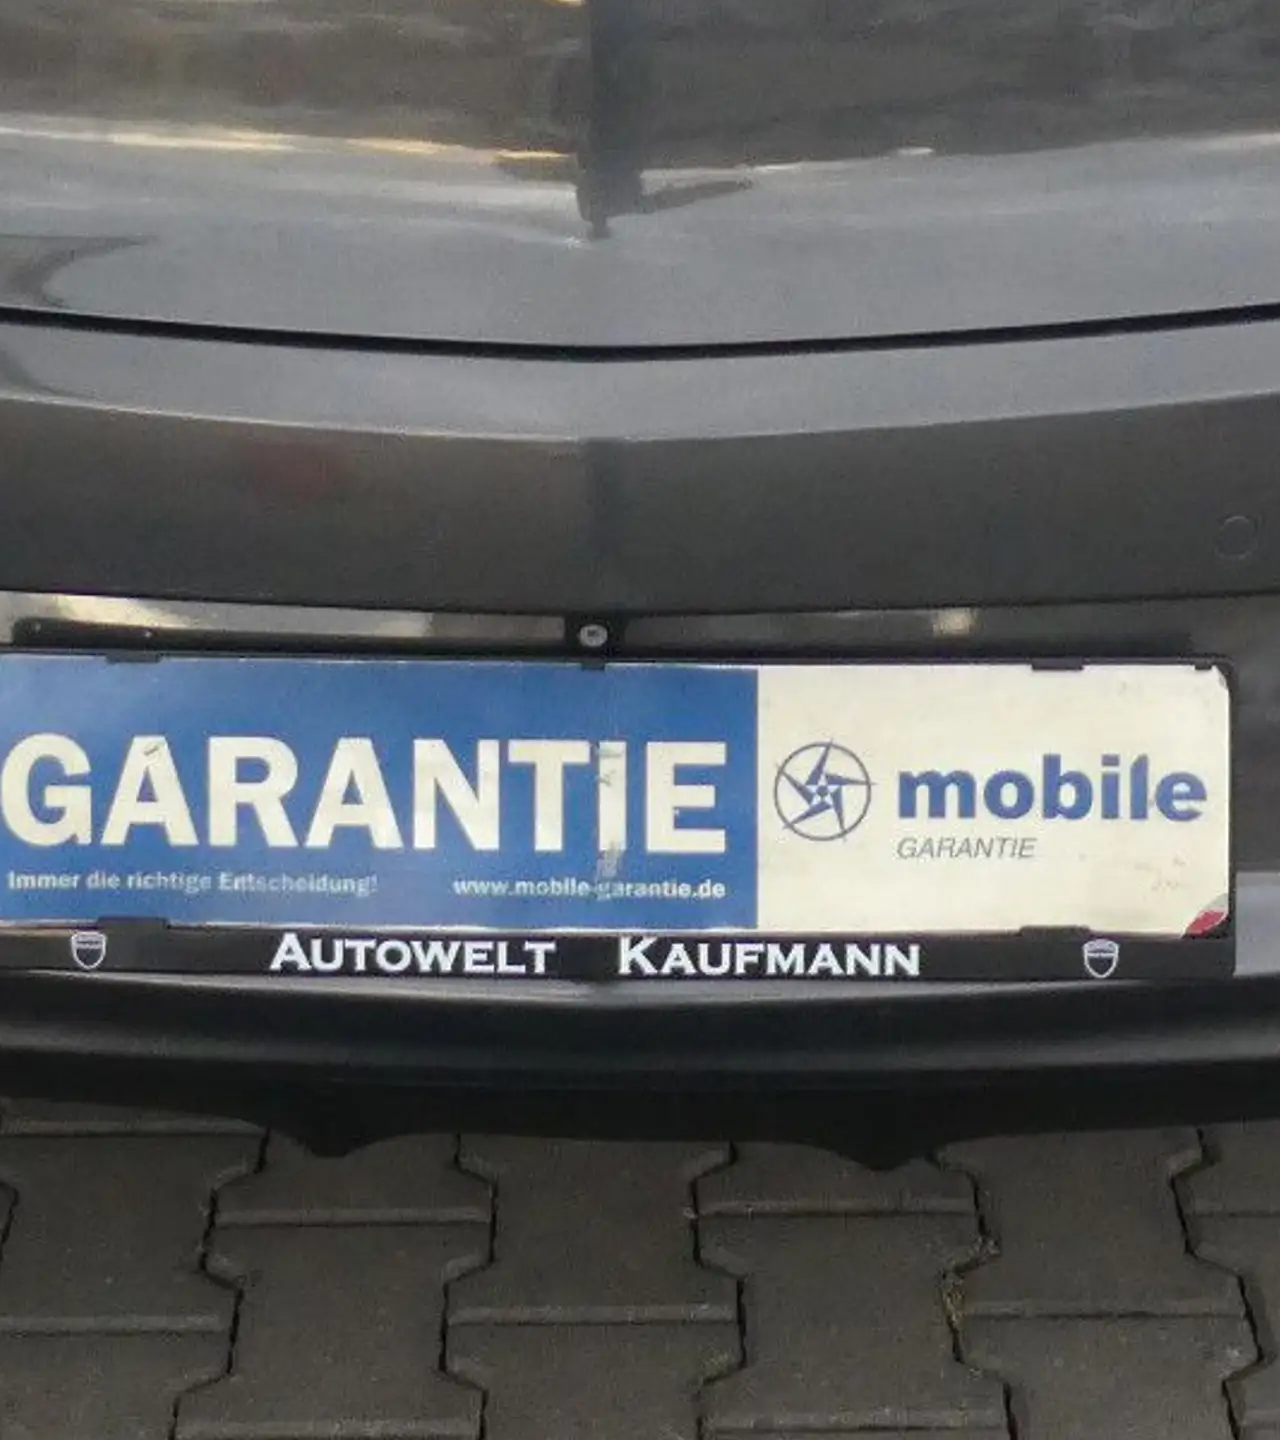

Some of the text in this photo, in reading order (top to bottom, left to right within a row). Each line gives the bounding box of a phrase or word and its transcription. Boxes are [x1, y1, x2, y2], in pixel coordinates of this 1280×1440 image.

[897, 752, 1208, 822] mobile
[896, 836, 1038, 860] GARANTIE
[7, 870, 378, 897] Immer die richtige Entscheidung!
[453, 877, 726, 900] www.mobile-garantie.de
[269, 932, 920, 977] AUTOWELT KAUFMANN
